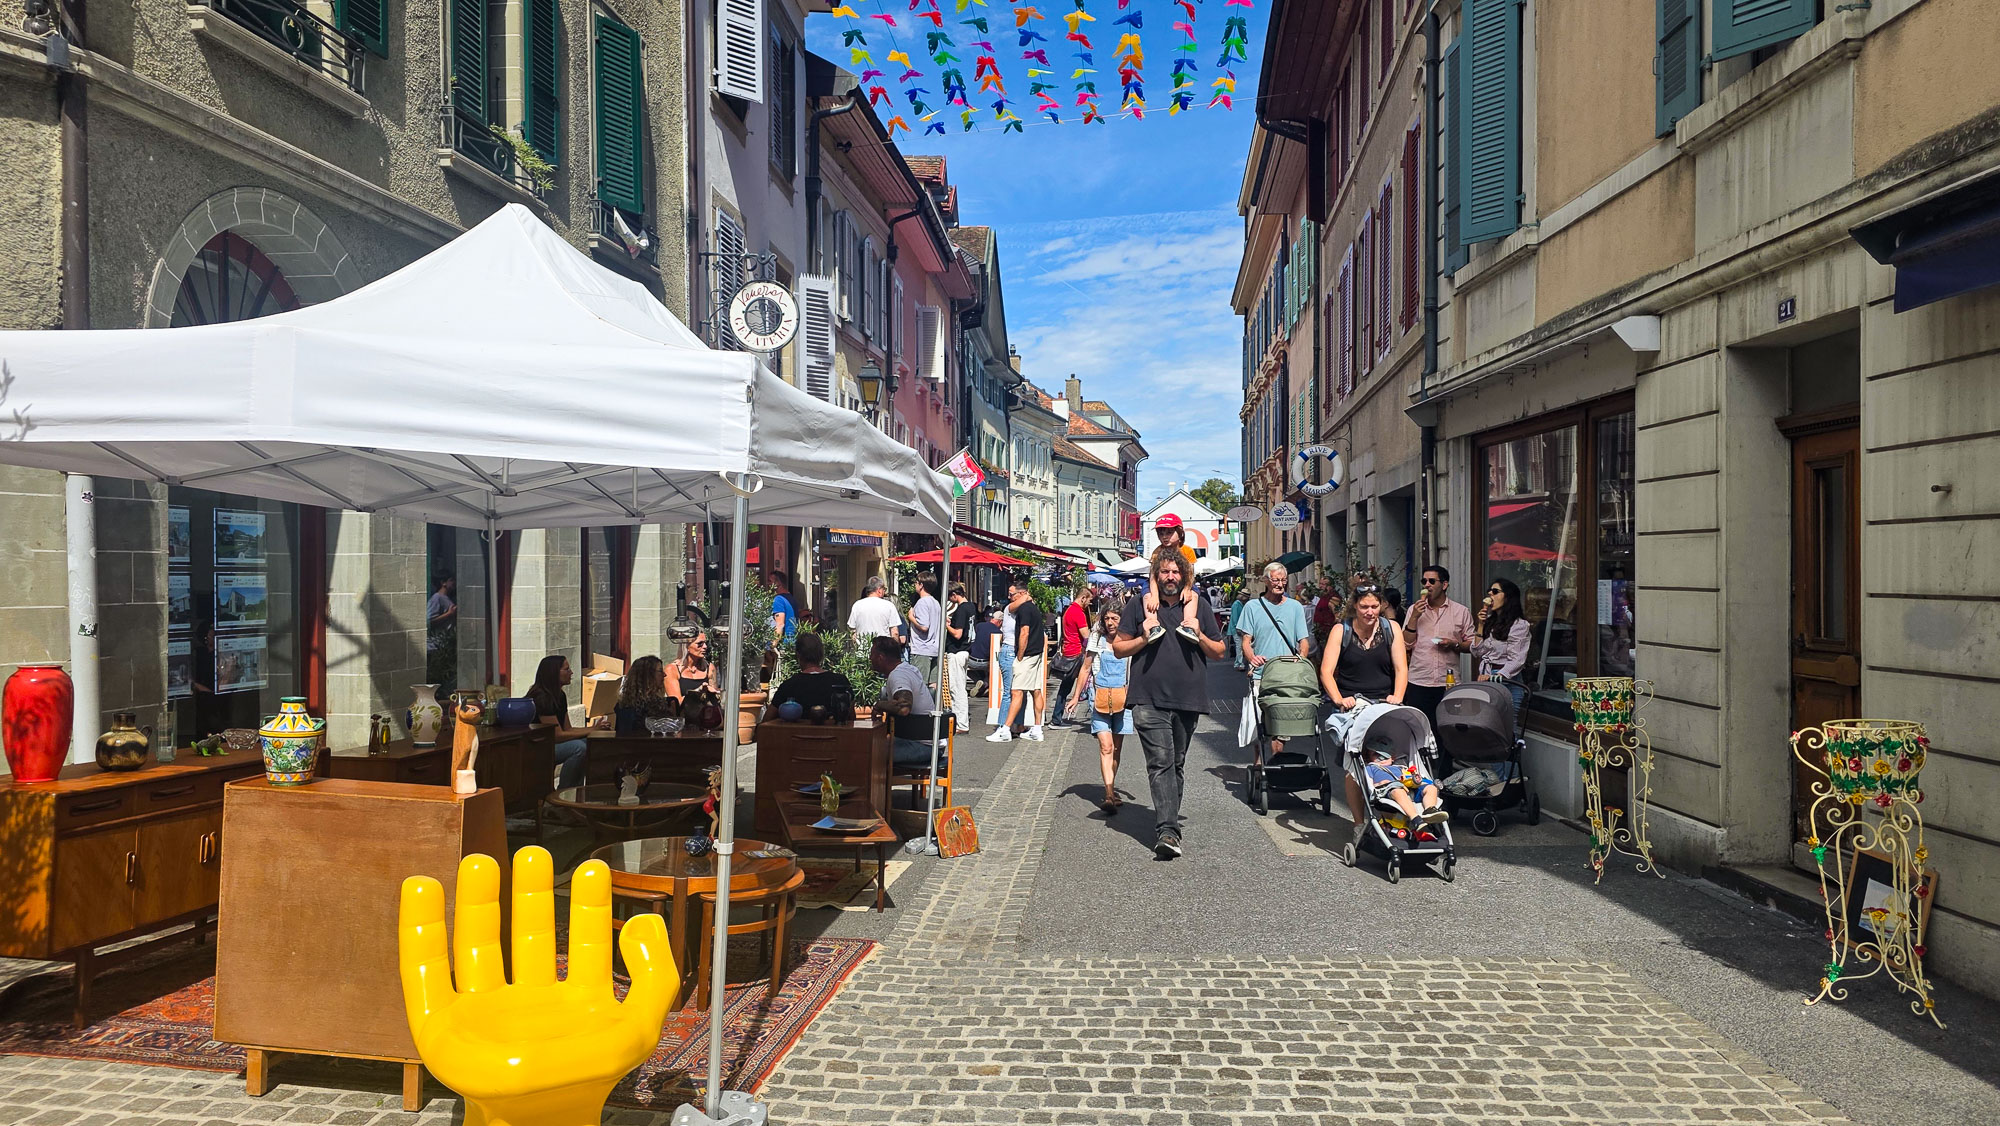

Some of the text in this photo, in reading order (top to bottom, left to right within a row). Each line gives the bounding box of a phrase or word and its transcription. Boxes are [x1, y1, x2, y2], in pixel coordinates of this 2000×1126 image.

[1780, 301, 1792, 318] 21
[735, 317, 793, 347] GELATERIA
[1308, 446, 1328, 454] RIVE
[1304, 485, 1333, 495] MARINE
